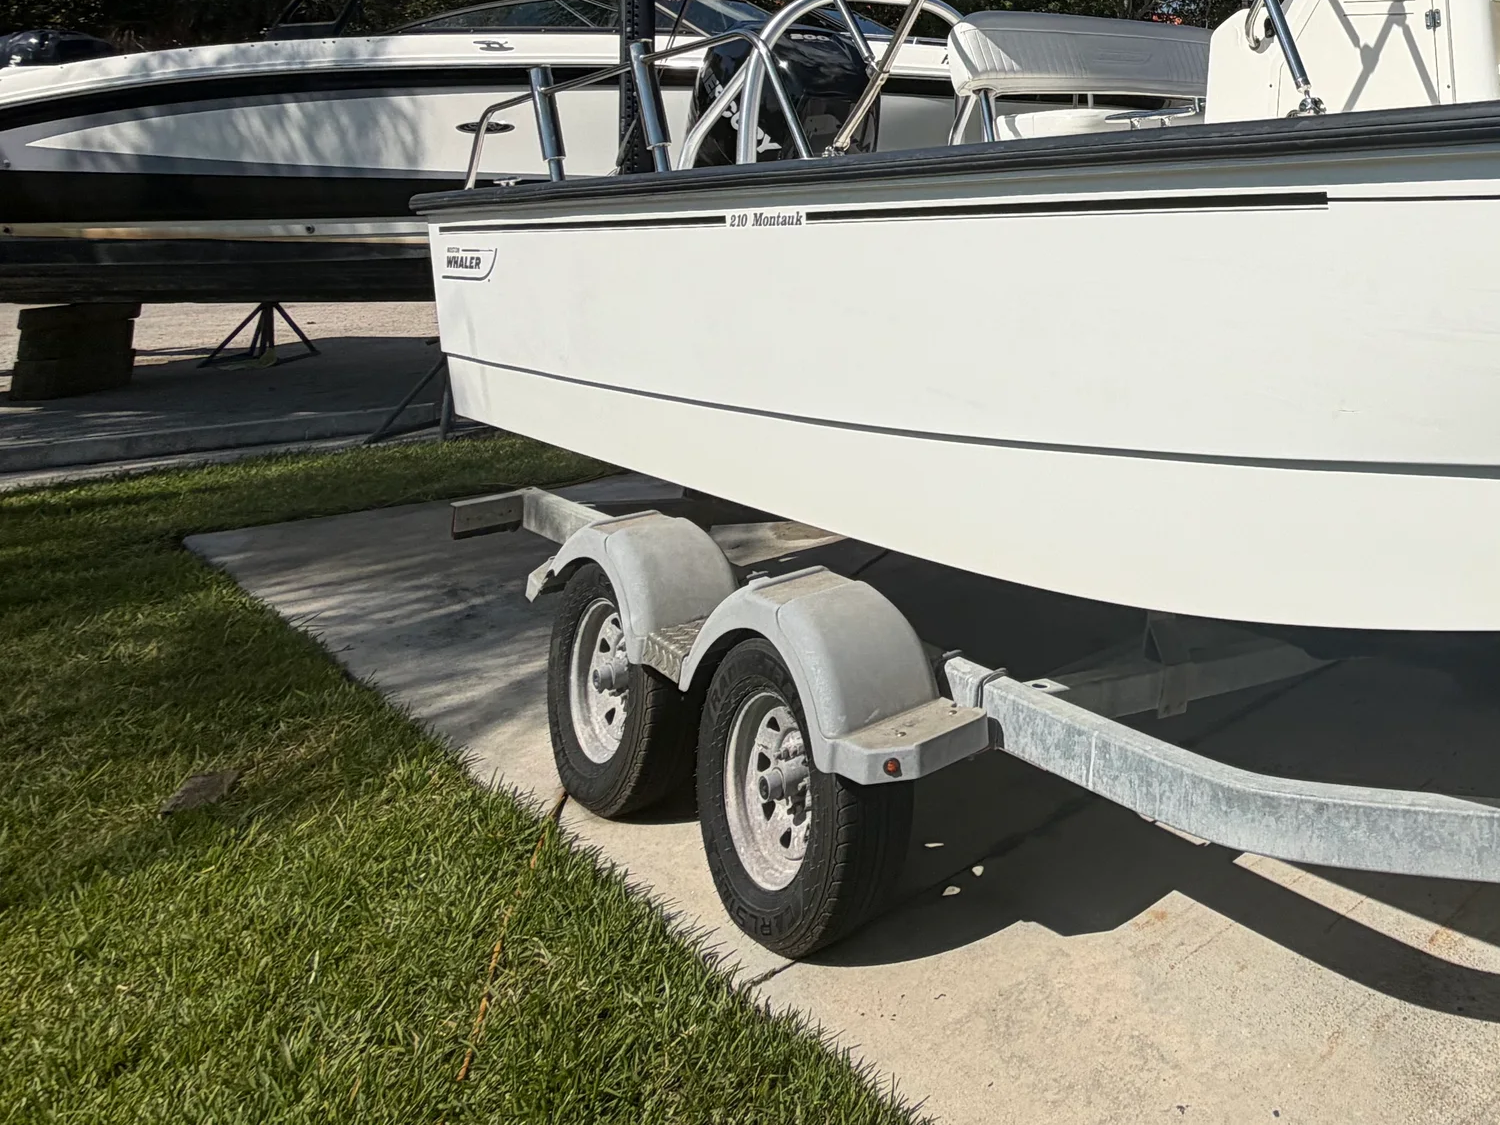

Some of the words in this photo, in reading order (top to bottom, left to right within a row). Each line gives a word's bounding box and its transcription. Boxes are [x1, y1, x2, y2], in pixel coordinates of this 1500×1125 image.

[729, 213, 748, 227] 210
[752, 210, 803, 227] Montauk
[446, 255, 482, 270] WHALER
